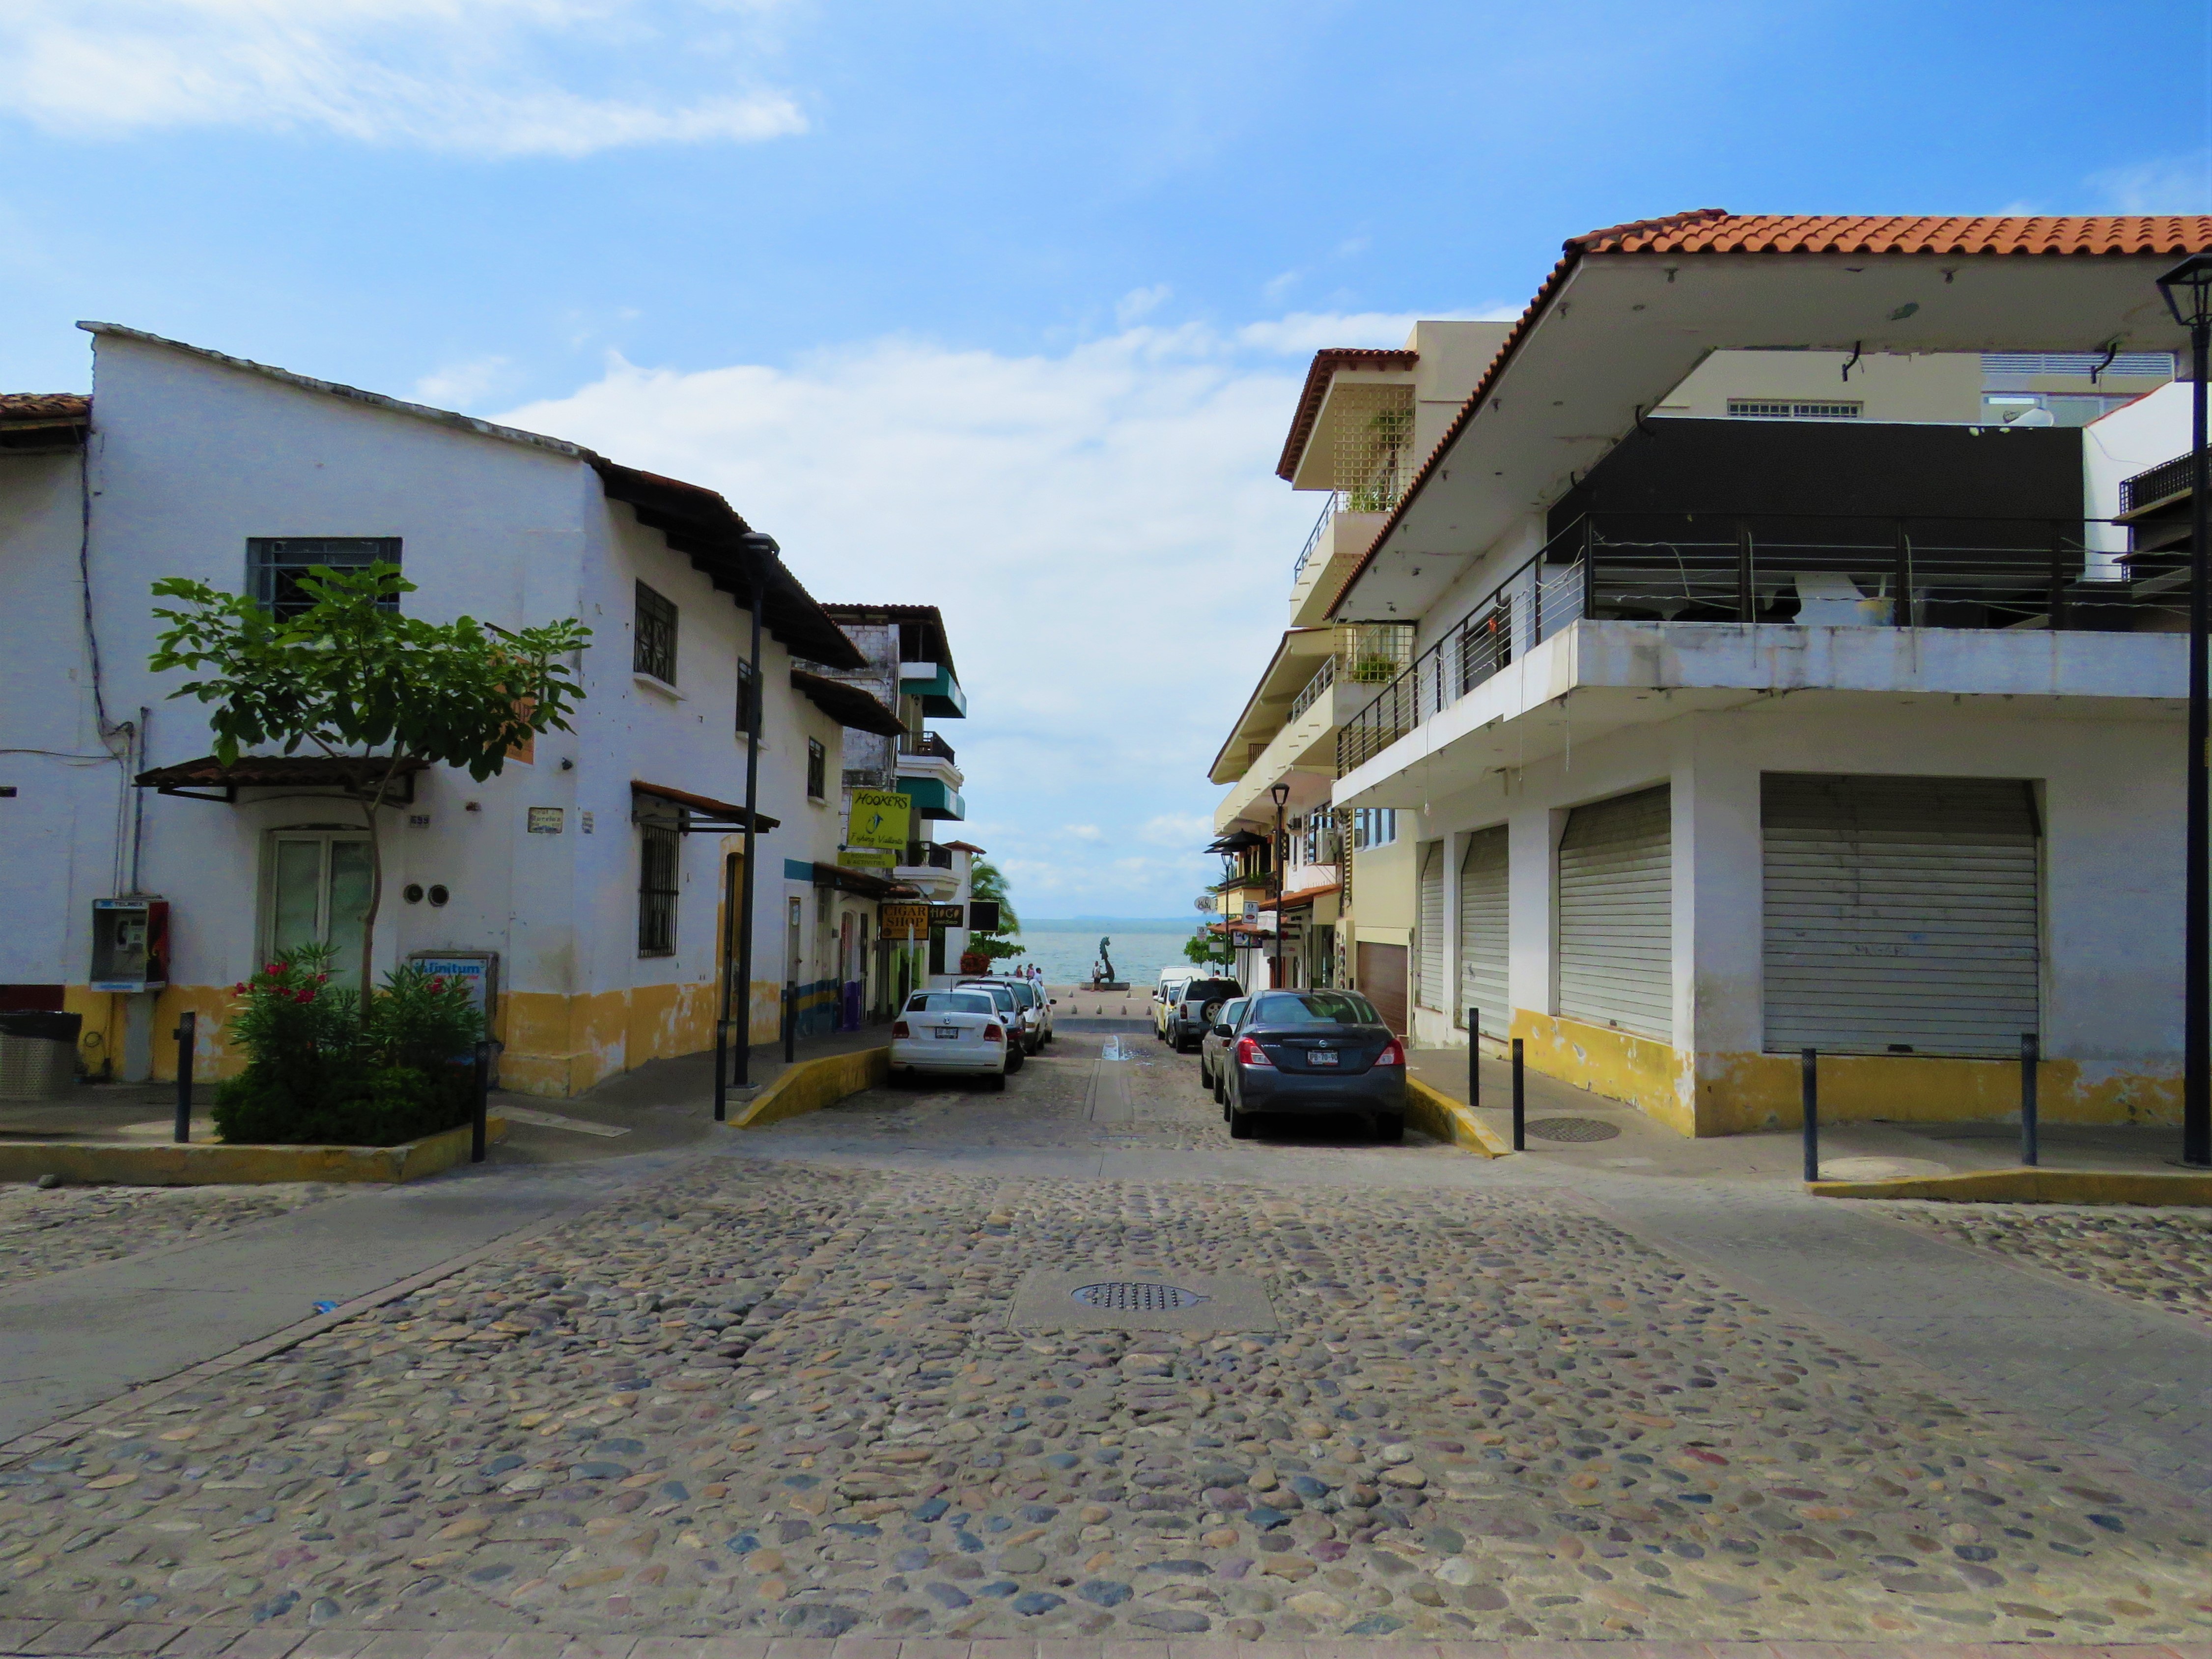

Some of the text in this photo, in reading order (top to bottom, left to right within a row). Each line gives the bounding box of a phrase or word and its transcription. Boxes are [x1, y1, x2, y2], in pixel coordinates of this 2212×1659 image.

[855, 793, 908, 809] HOOKERS
[885, 906, 926, 916] CIGAR
[886, 917, 924, 927] SHOP
